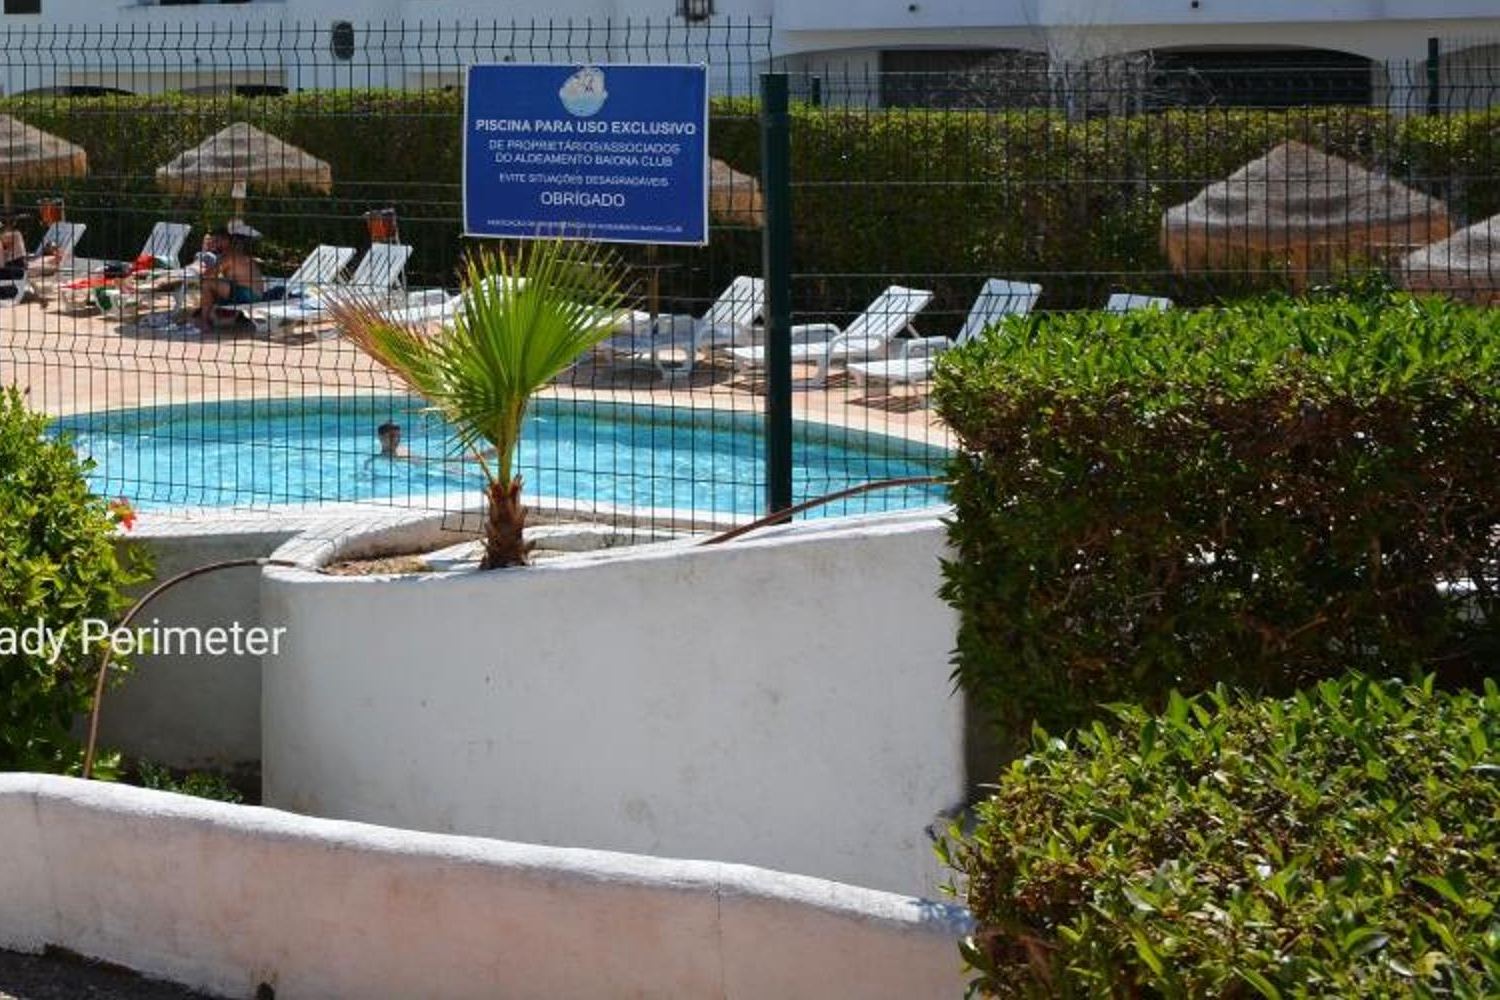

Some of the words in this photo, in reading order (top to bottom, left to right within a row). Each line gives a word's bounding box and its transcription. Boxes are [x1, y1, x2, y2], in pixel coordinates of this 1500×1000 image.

[476, 120, 531, 131] PISCINA
[536, 120, 574, 132] PARA
[577, 121, 607, 133] USO
[611, 121, 697, 135] EXCLUSIVO
[489, 140, 504, 150] DE
[495, 152, 513, 162] DO
[641, 155, 673, 167] CLUB
[541, 191, 625, 207] OBRIGADO
